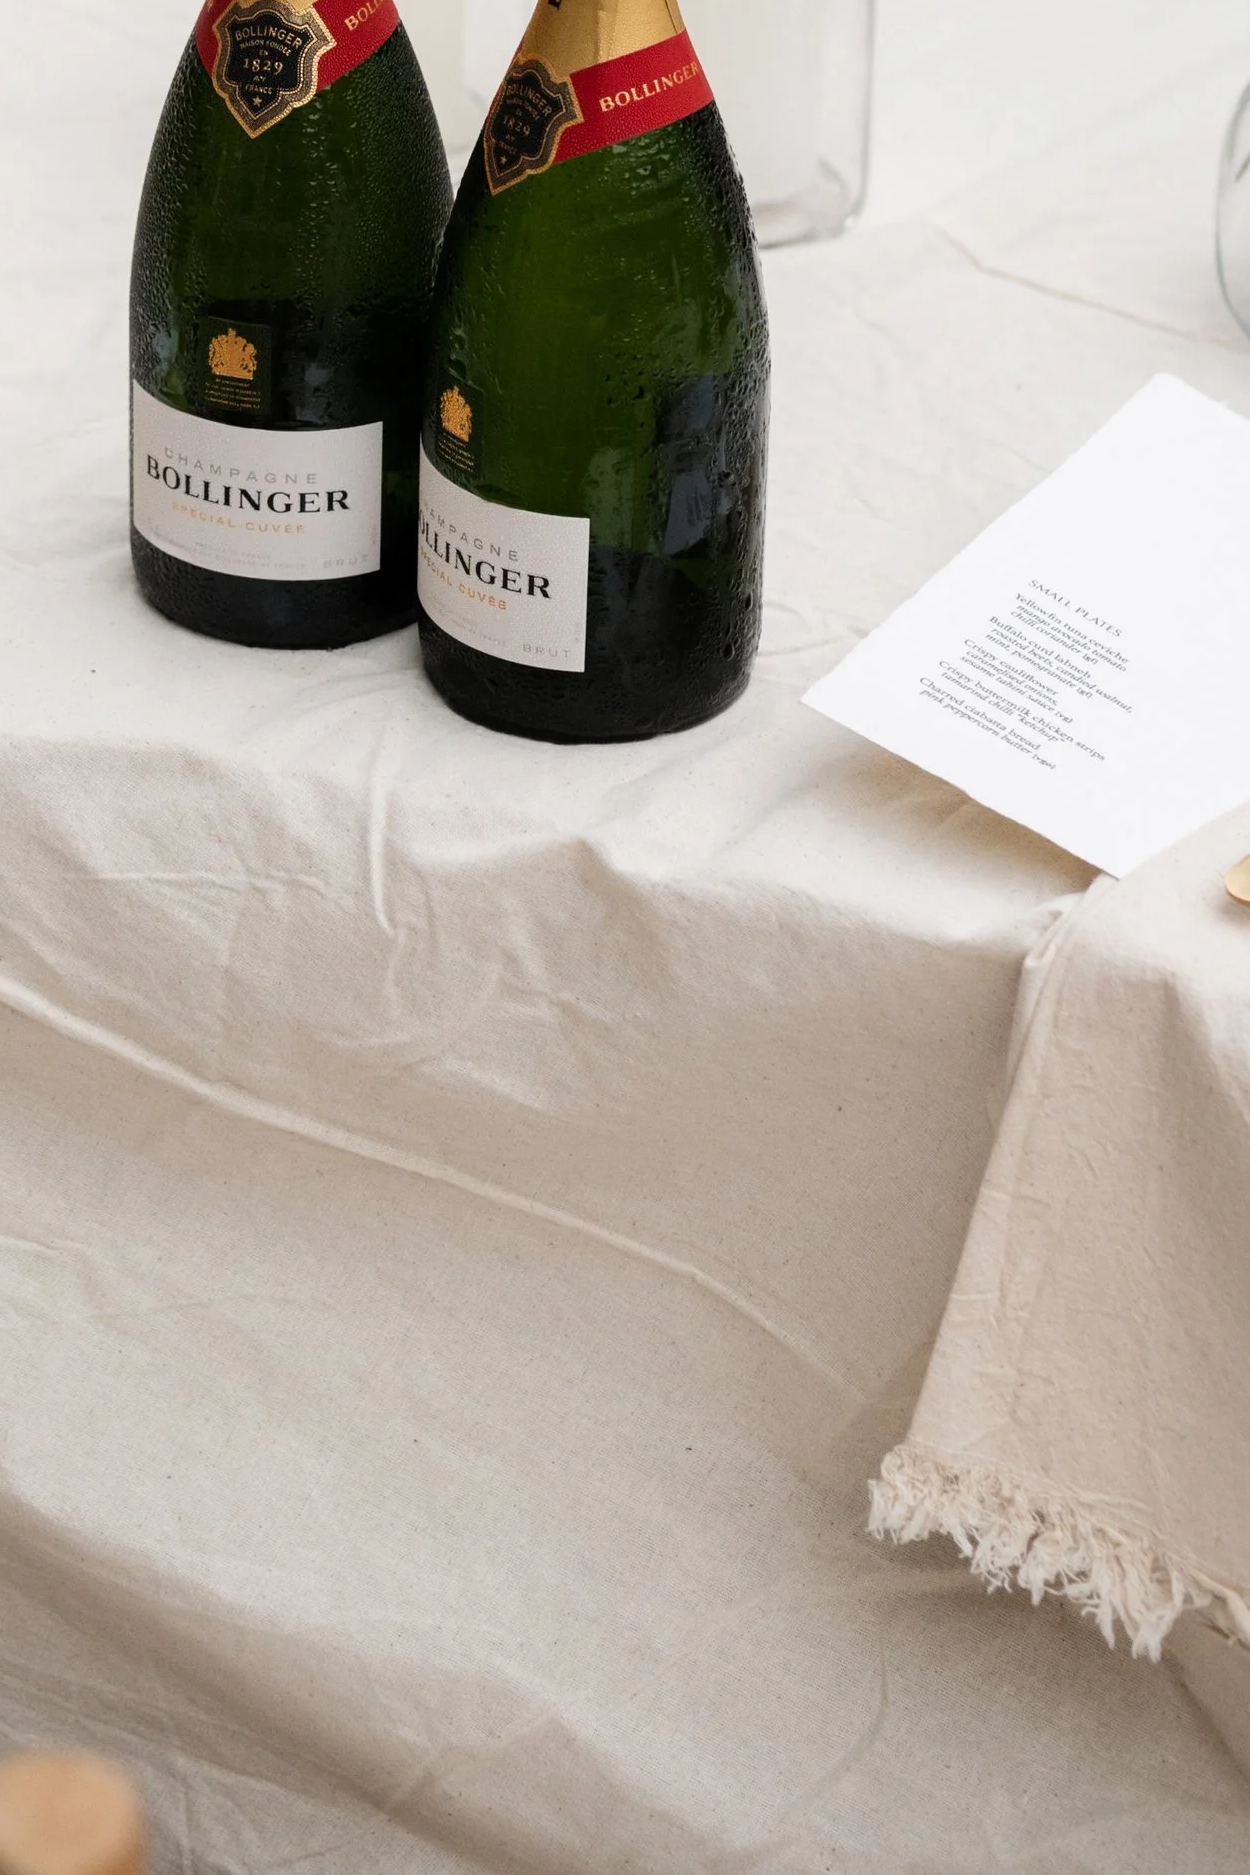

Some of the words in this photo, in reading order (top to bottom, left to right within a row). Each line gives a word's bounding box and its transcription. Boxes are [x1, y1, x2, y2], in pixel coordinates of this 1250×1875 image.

[235, 26, 303, 49] BOLLINGER
[243, 58, 284, 75] 1829
[244, 84, 273, 95] FRANCE
[599, 61, 699, 112] BOLLINGER
[146, 454, 351, 514] BOLLINGER
[165, 446, 318, 485] CHAMPAGNE
[171, 501, 236, 529] SPECIAL
[322, 554, 370, 569] BRUT
[458, 582, 507, 611] CUVÉE
[1029, 579, 1071, 608] SMALL
[1075, 607, 1123, 637] PLATES
[522, 643, 571, 658] BRUT
[990, 615, 1027, 641] Buffalo
[1028, 640, 1054, 656] curd
[1054, 653, 1091, 679] labneh
[1010, 611, 1036, 628] chilli
[1036, 626, 1082, 654] coriander
[1015, 592, 1062, 625] Yellowfin
[1063, 623, 1087, 640] tuna
[1089, 638, 1129, 664] ceviche
[1016, 604, 1051, 628] mango
[1051, 626, 1091, 651] avocado
[1092, 649, 1127, 672] tomato
[961, 656, 996, 678] sesame
[996, 676, 1026, 695] tahini
[1026, 694, 1055, 712] sauce
[964, 639, 998, 661] Crispy
[999, 660, 1059, 696] cauliflower
[966, 651, 1027, 685] caramelised
[985, 634, 1011, 652] mint,
[1011, 650, 1076, 688] pomegranate
[991, 628, 1029, 651] roasted
[1056, 666, 1096, 689] candied
[1096, 689, 1133, 713] walnut,
[920, 677, 965, 705] Charred
[964, 705, 1007, 731] ciabatta
[1008, 728, 1041, 750] bread
[939, 660, 974, 683] Crispy
[975, 680, 1031, 717] buttermilk
[1032, 715, 1074, 743] chicken
[1075, 741, 1106, 761] strips
[941, 672, 989, 701] tamarind
[988, 700, 1014, 716] chilli
[919, 689, 945, 704] pink
[943, 703, 1000, 736] peppercorn
[1001, 734, 1033, 754] butter
